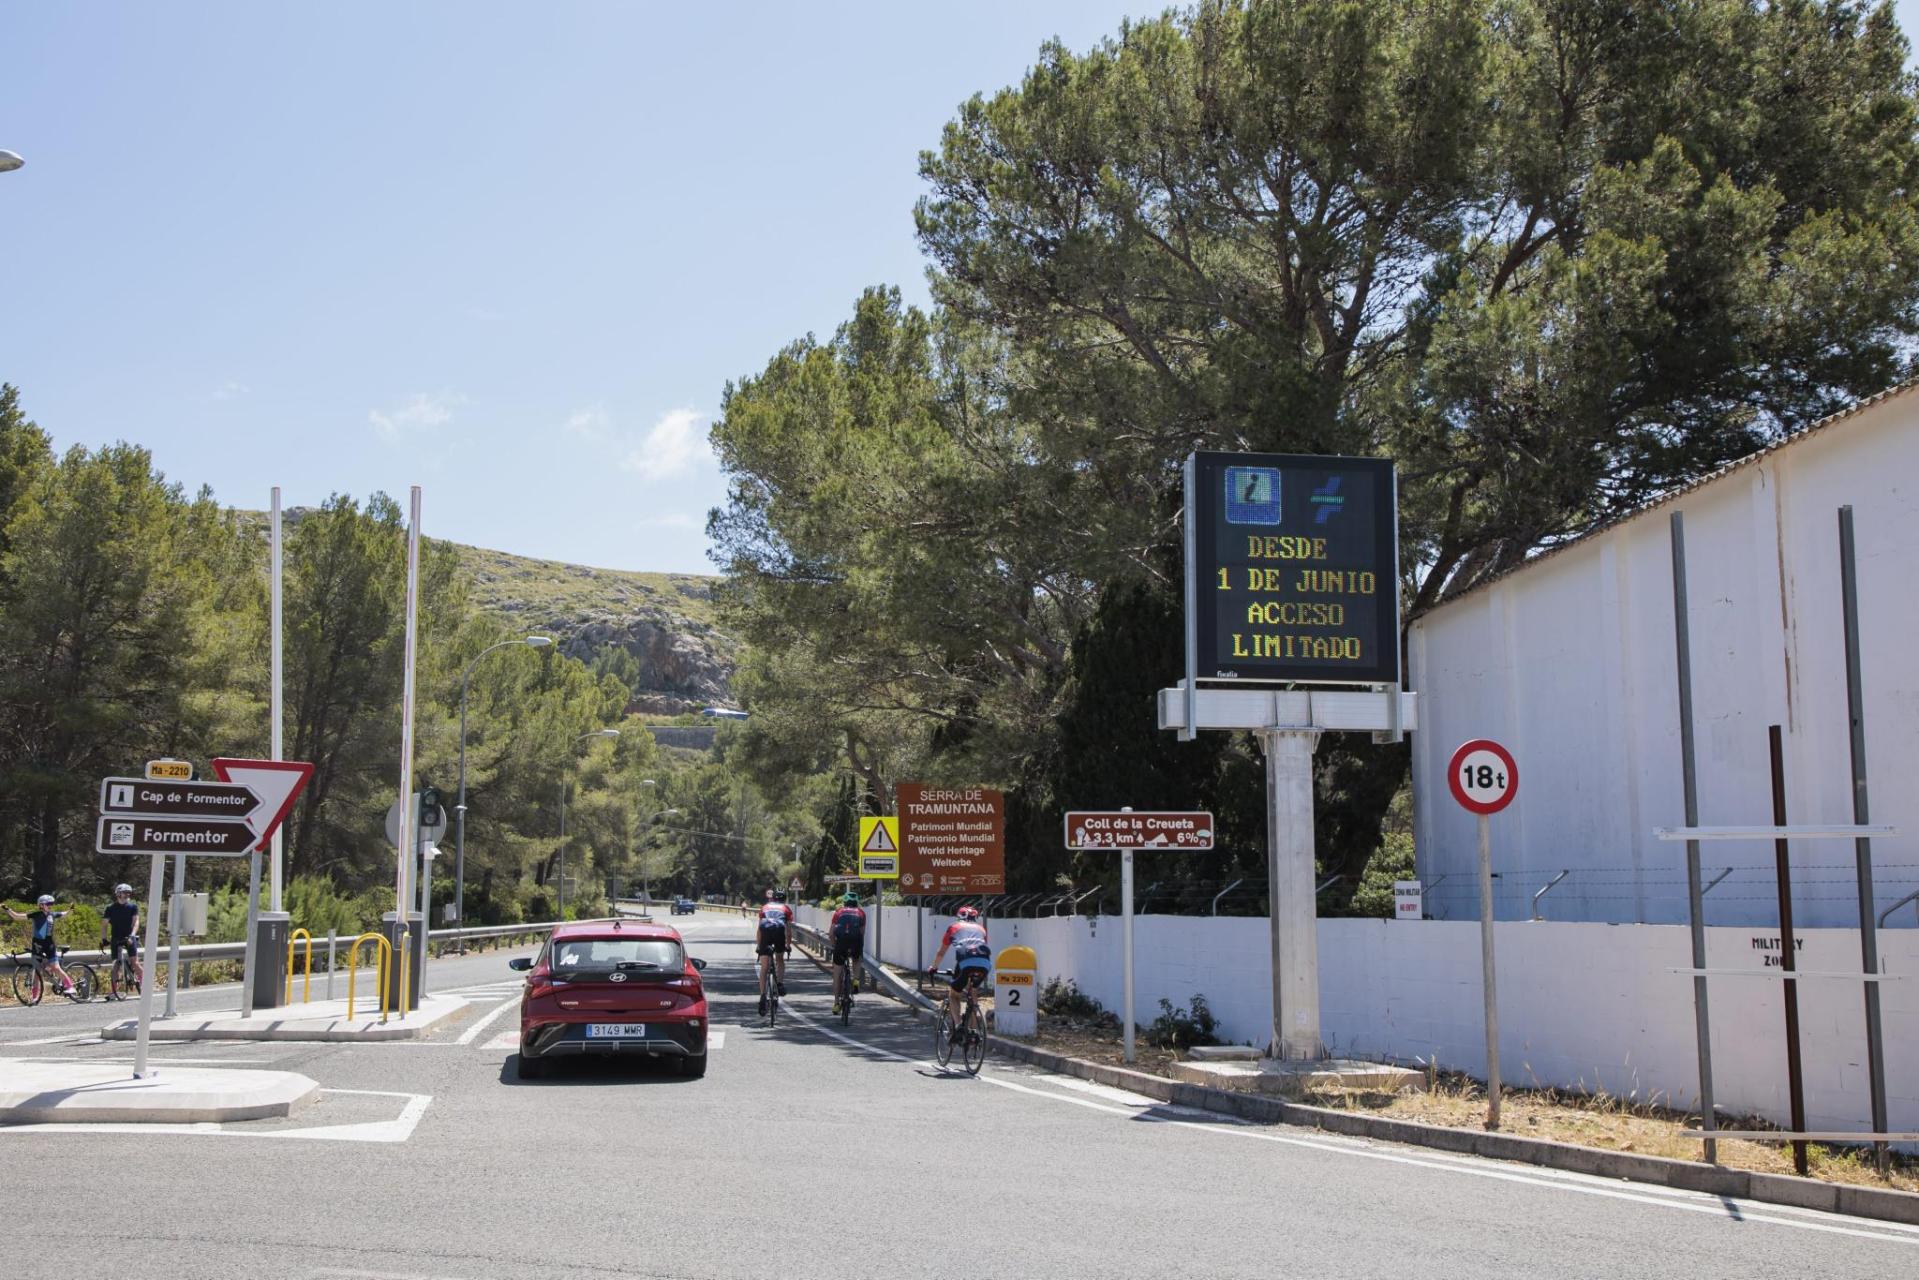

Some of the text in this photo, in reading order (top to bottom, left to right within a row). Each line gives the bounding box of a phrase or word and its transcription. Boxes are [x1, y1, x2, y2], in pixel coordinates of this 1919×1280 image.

[1248, 536, 1327, 559] DESDE
[1217, 568, 1375, 595] 1 DE JUNIO
[1248, 602, 1344, 625] ACCESO
[1232, 634, 1361, 660] LIMITADO
[141, 790, 246, 805] Cap de Formentor
[920, 790, 982, 801] SERRA DE
[908, 803, 995, 814] TRAMUNTANA
[911, 822, 992, 831] Patrimoni Mundial
[1084, 818, 1194, 829] Coll de la Creueta
[144, 828, 228, 844] Formentor
[908, 834, 995, 843] Patrimonio Mundial
[1116, 833, 1134, 843] km
[918, 846, 985, 857] World Heritage
[931, 858, 972, 867] Welterbe
[1752, 938, 1803, 950] MILITY
[1008, 989, 1020, 1006] 2
[594, 1025, 642, 1036] 3149 MMR
